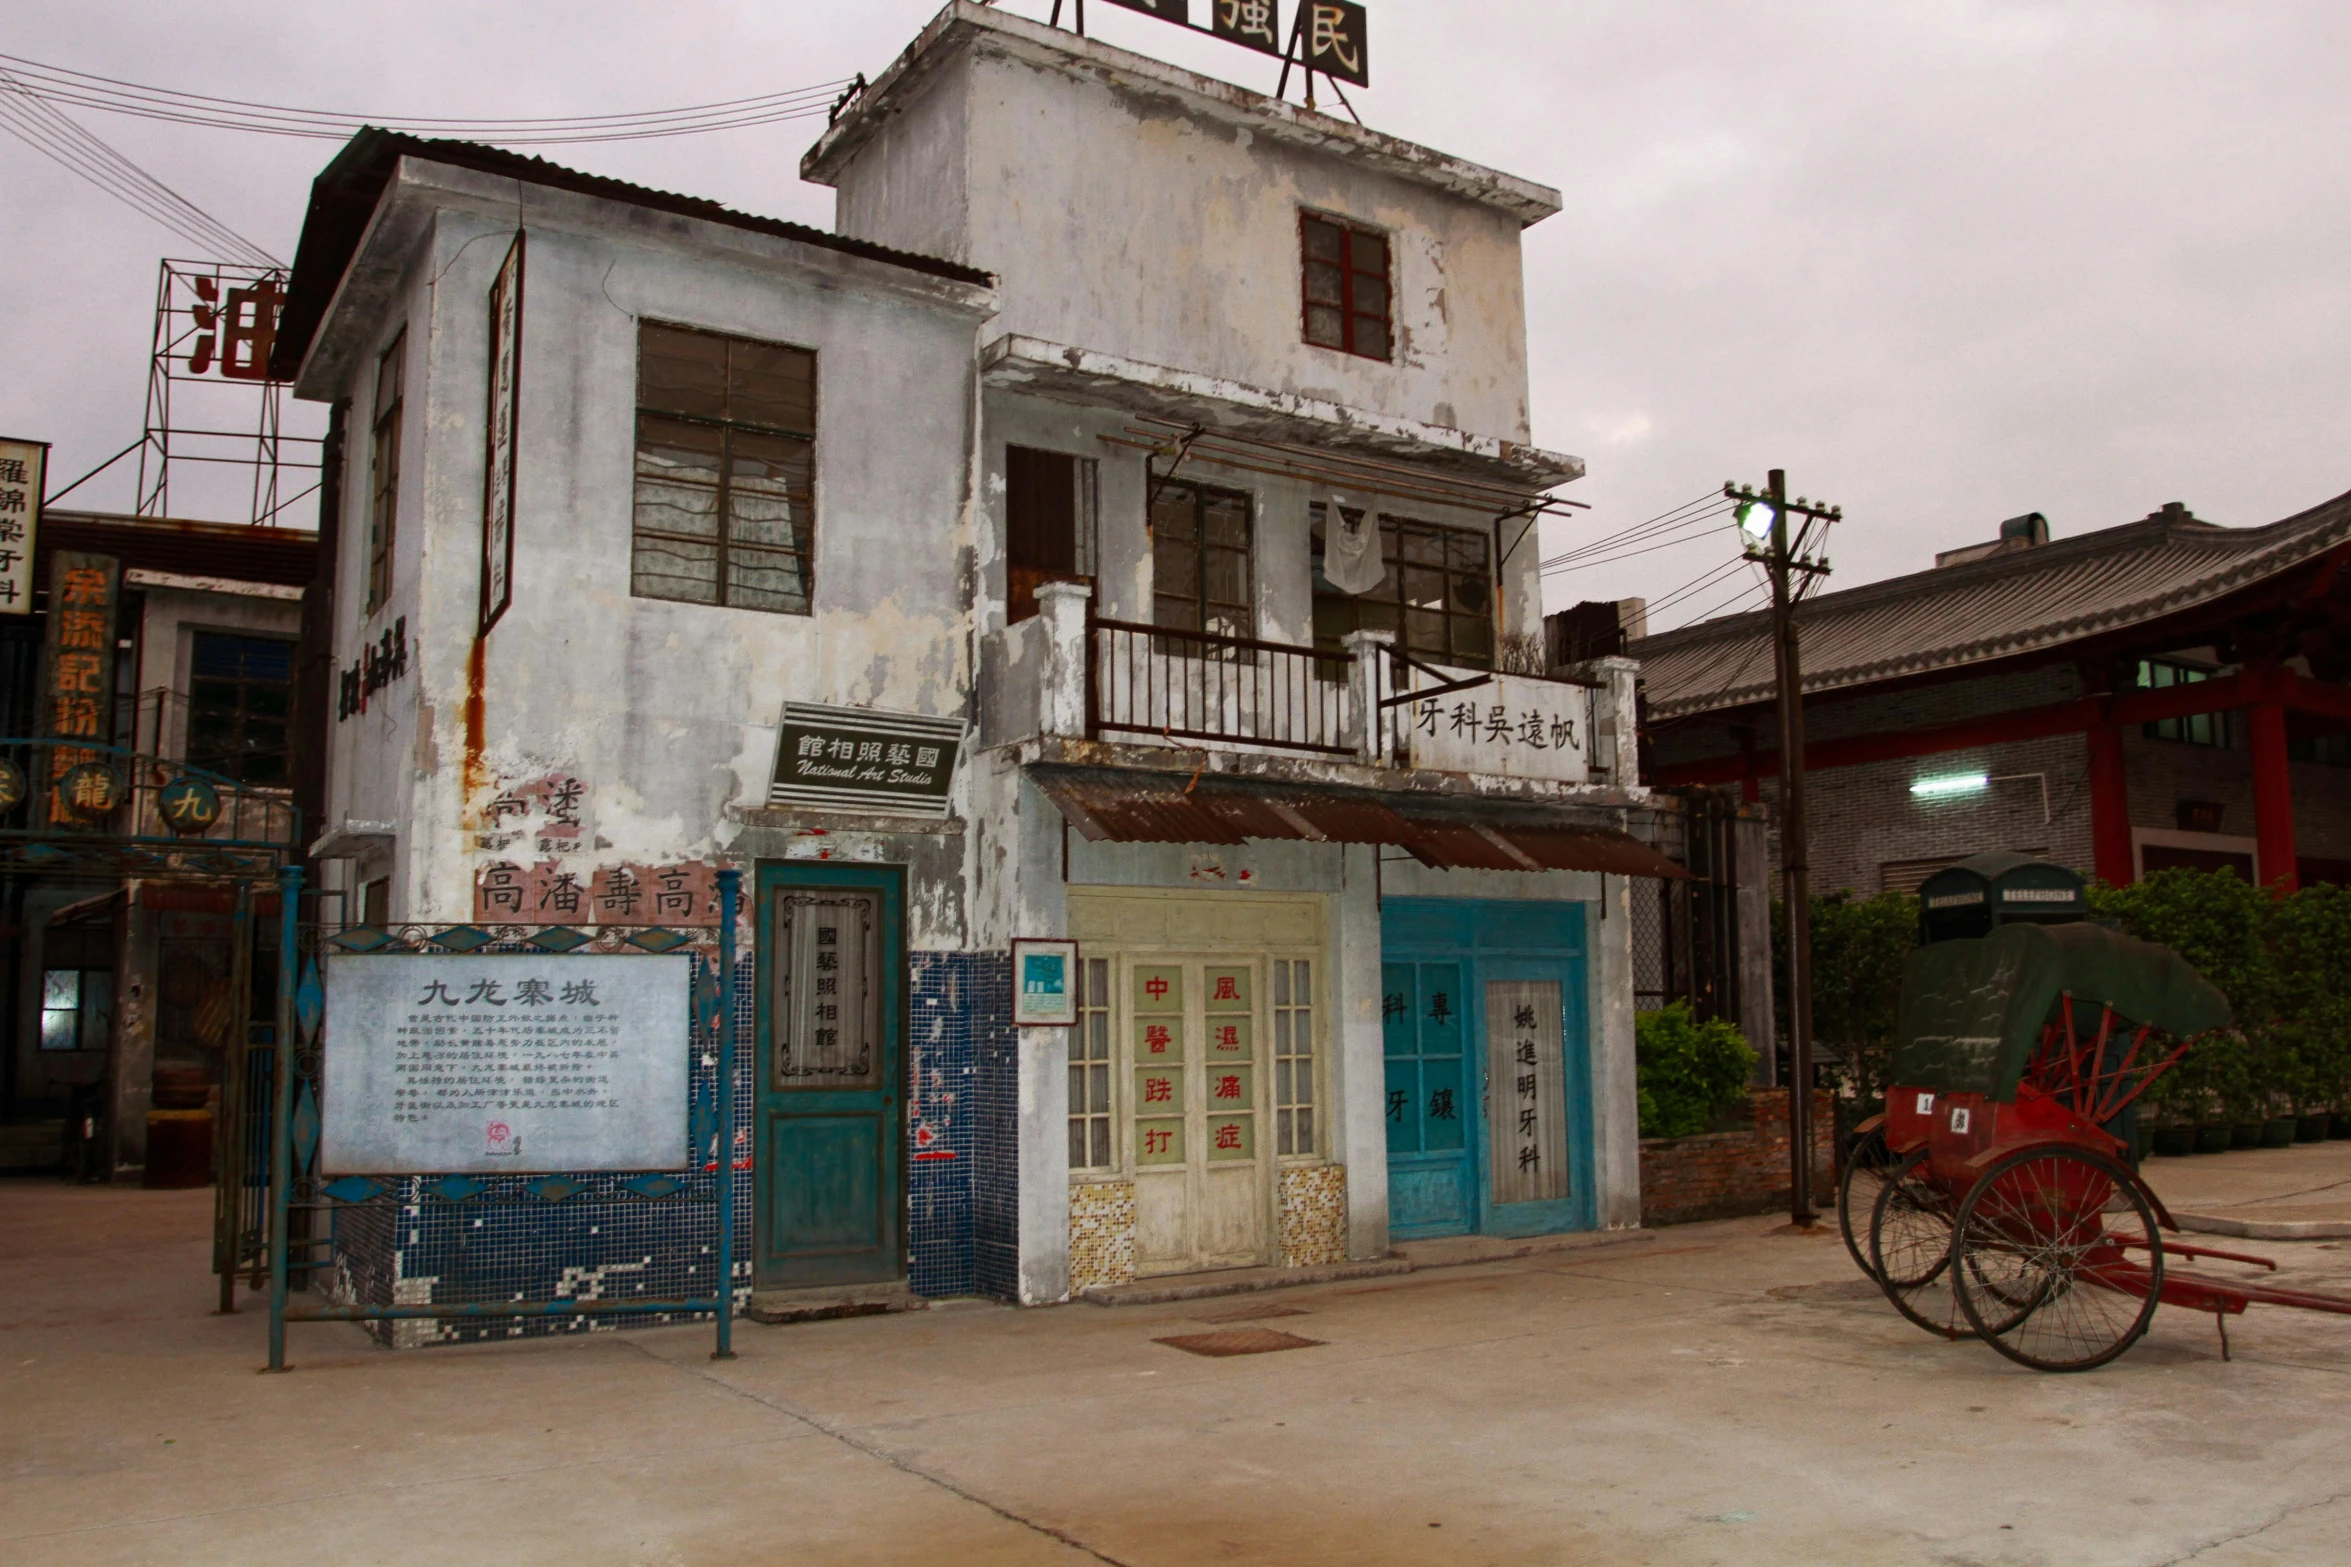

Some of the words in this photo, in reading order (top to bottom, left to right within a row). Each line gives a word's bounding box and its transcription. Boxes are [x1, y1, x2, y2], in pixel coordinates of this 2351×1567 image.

[796, 759, 857, 779] National
[855, 765, 886, 781] Art
[887, 769, 933, 785] Studio
[417, 978, 601, 1007] 九龙寨城
[814, 927, 839, 1047] 國藝照相館
[1145, 976, 1173, 1154] 中醫跌打
[1513, 1004, 1541, 1174] 姚進明牙科
